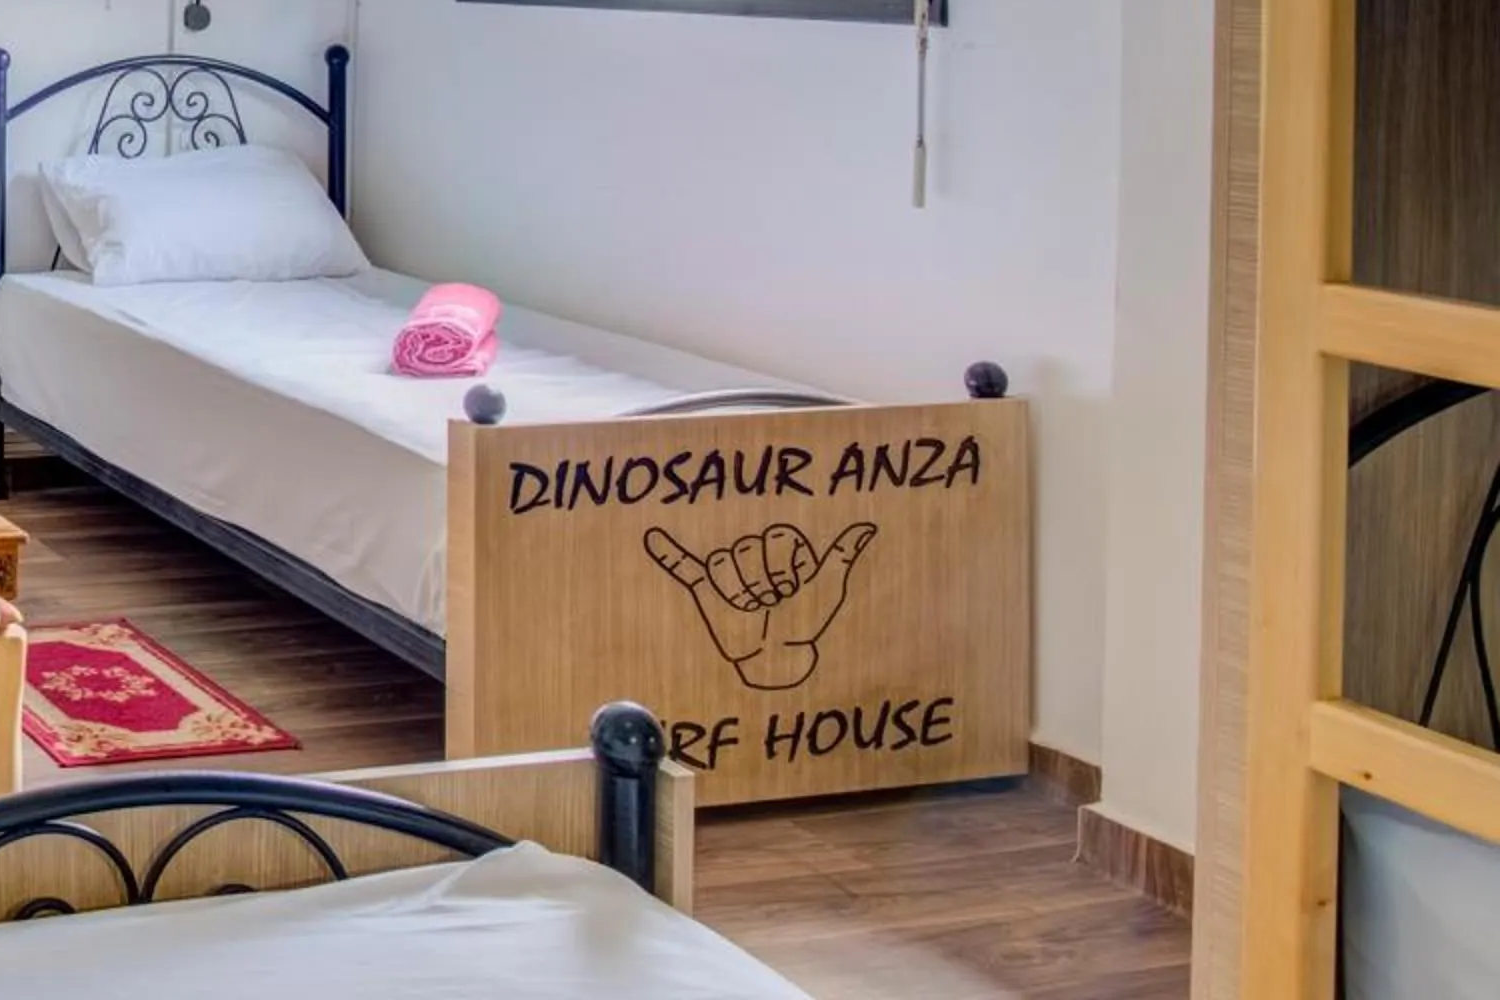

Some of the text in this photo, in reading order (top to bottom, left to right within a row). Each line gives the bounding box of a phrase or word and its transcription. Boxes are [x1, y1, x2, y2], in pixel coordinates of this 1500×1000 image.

[510, 436, 981, 514] DINOSAUR ANZA
[661, 698, 954, 770] RF HOUSE
